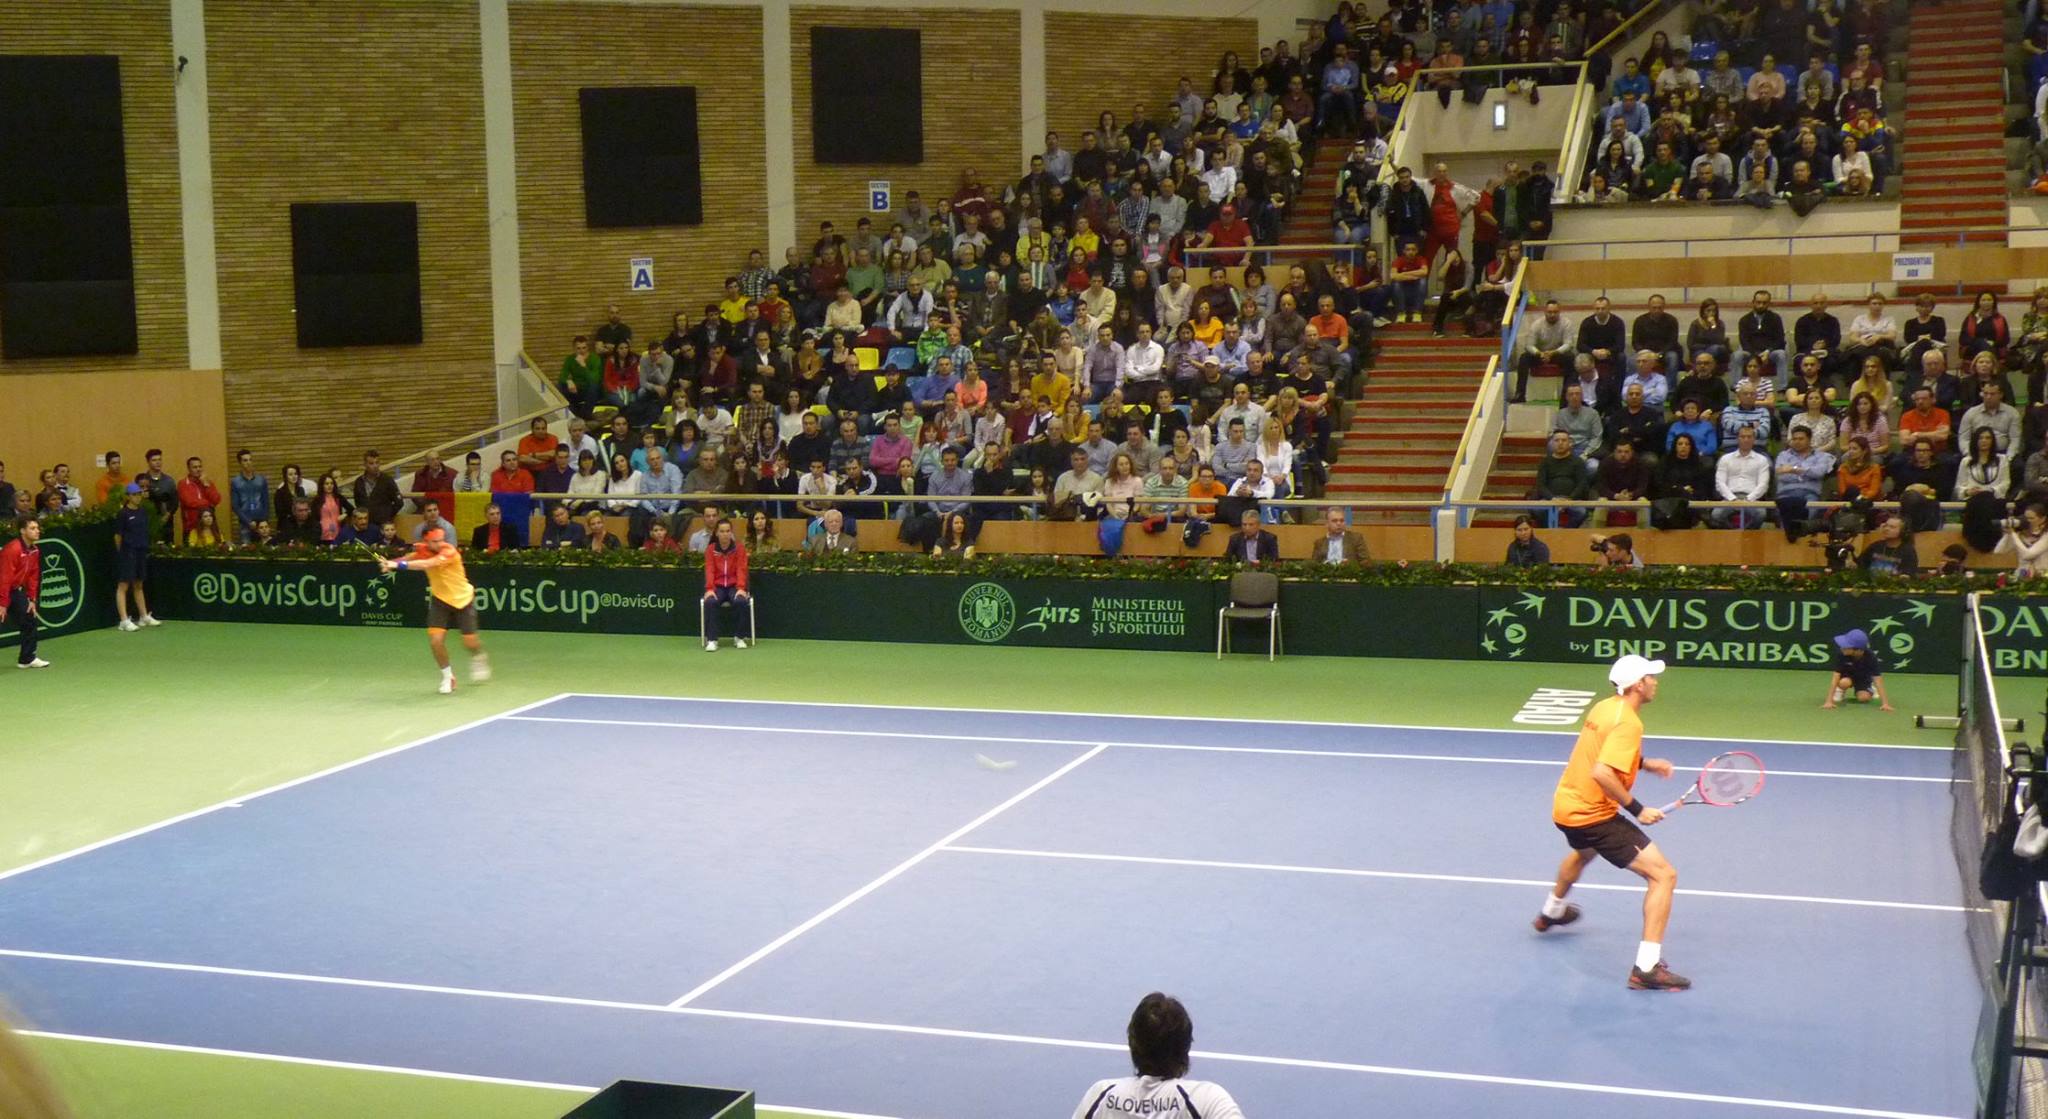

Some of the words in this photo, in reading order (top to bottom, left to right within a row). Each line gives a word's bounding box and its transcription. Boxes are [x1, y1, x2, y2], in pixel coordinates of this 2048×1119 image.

[872, 191, 888, 210] B
[633, 268, 652, 288] A
[194, 572, 356, 617] @DavisCup
[425, 579, 599, 624] avisCup
[600, 594, 675, 612] @DavisCup
[1092, 597, 1185, 611] MINISTERUL
[1039, 607, 1080, 624] MTS
[1092, 609, 1184, 623] TINERETULUI
[1569, 597, 1708, 630] DAVIS
[1725, 600, 1831, 631] CUP
[1109, 622, 1185, 635] SPORTULUI
[1570, 641, 1589, 653] by
[1594, 638, 1666, 658] BNP
[1677, 641, 1830, 663] PARIBAS
[1512, 687, 1597, 724] ARAD
[1106, 1094, 1181, 1114] SLOVENIJA
